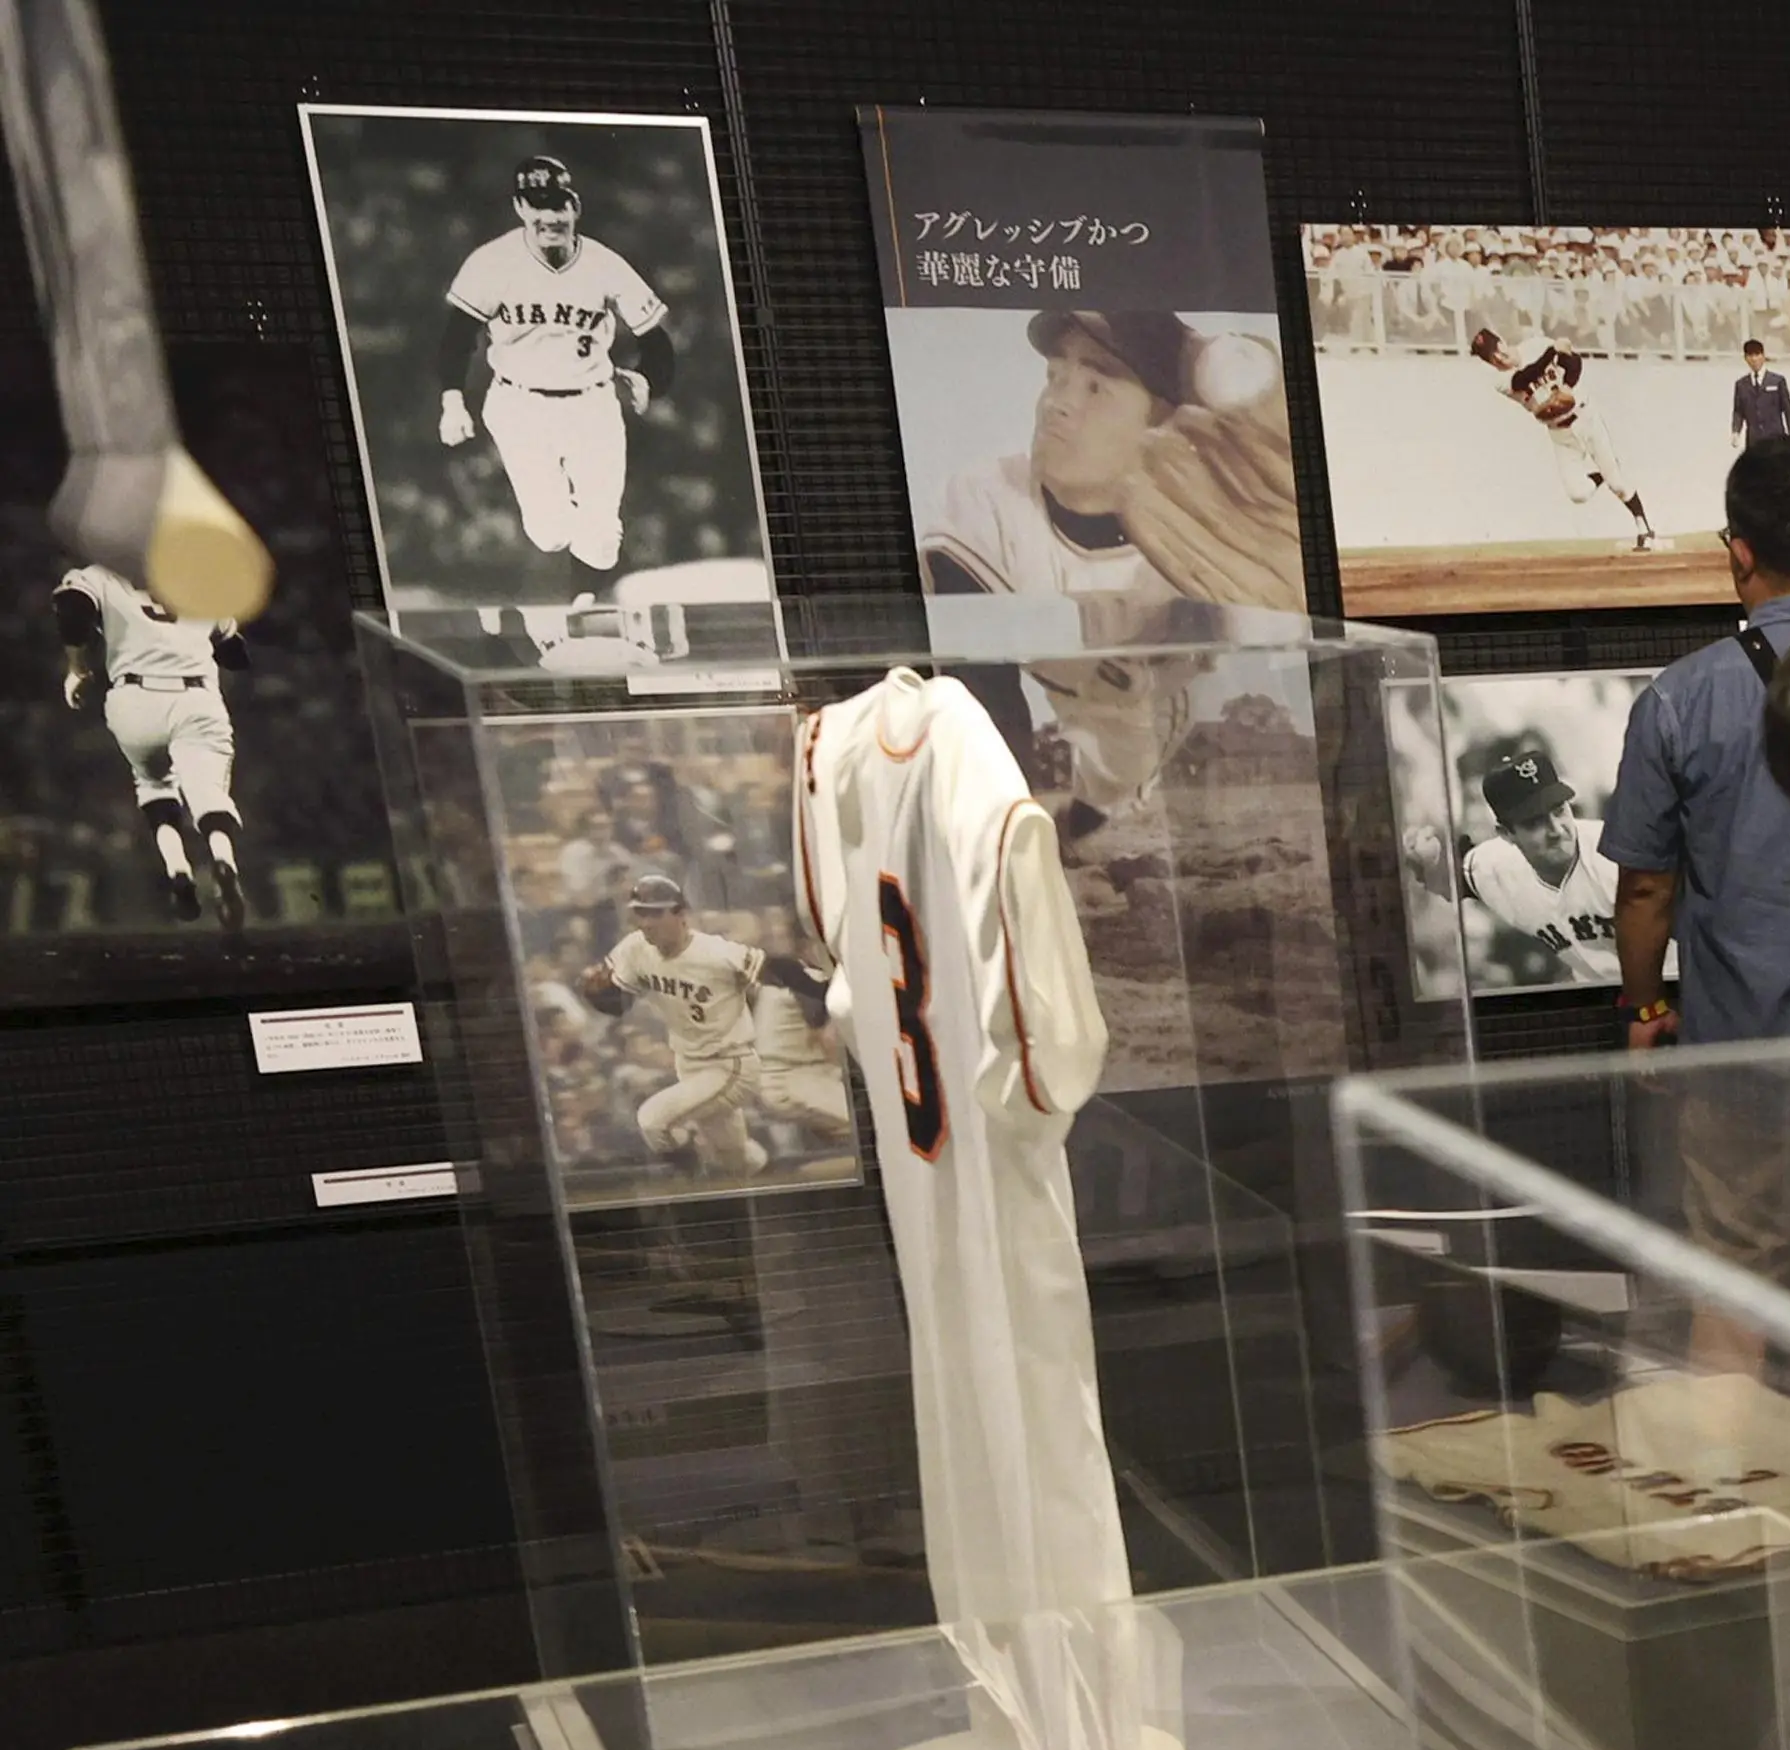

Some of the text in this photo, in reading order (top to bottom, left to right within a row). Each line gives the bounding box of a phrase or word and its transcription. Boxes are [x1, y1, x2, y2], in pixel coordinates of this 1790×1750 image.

[914, 210, 1150, 245] アグレッシブかつ
[917, 251, 1081, 290] 華麗な守備
[577, 335, 593, 357] 3
[877, 869, 950, 1163] 3
